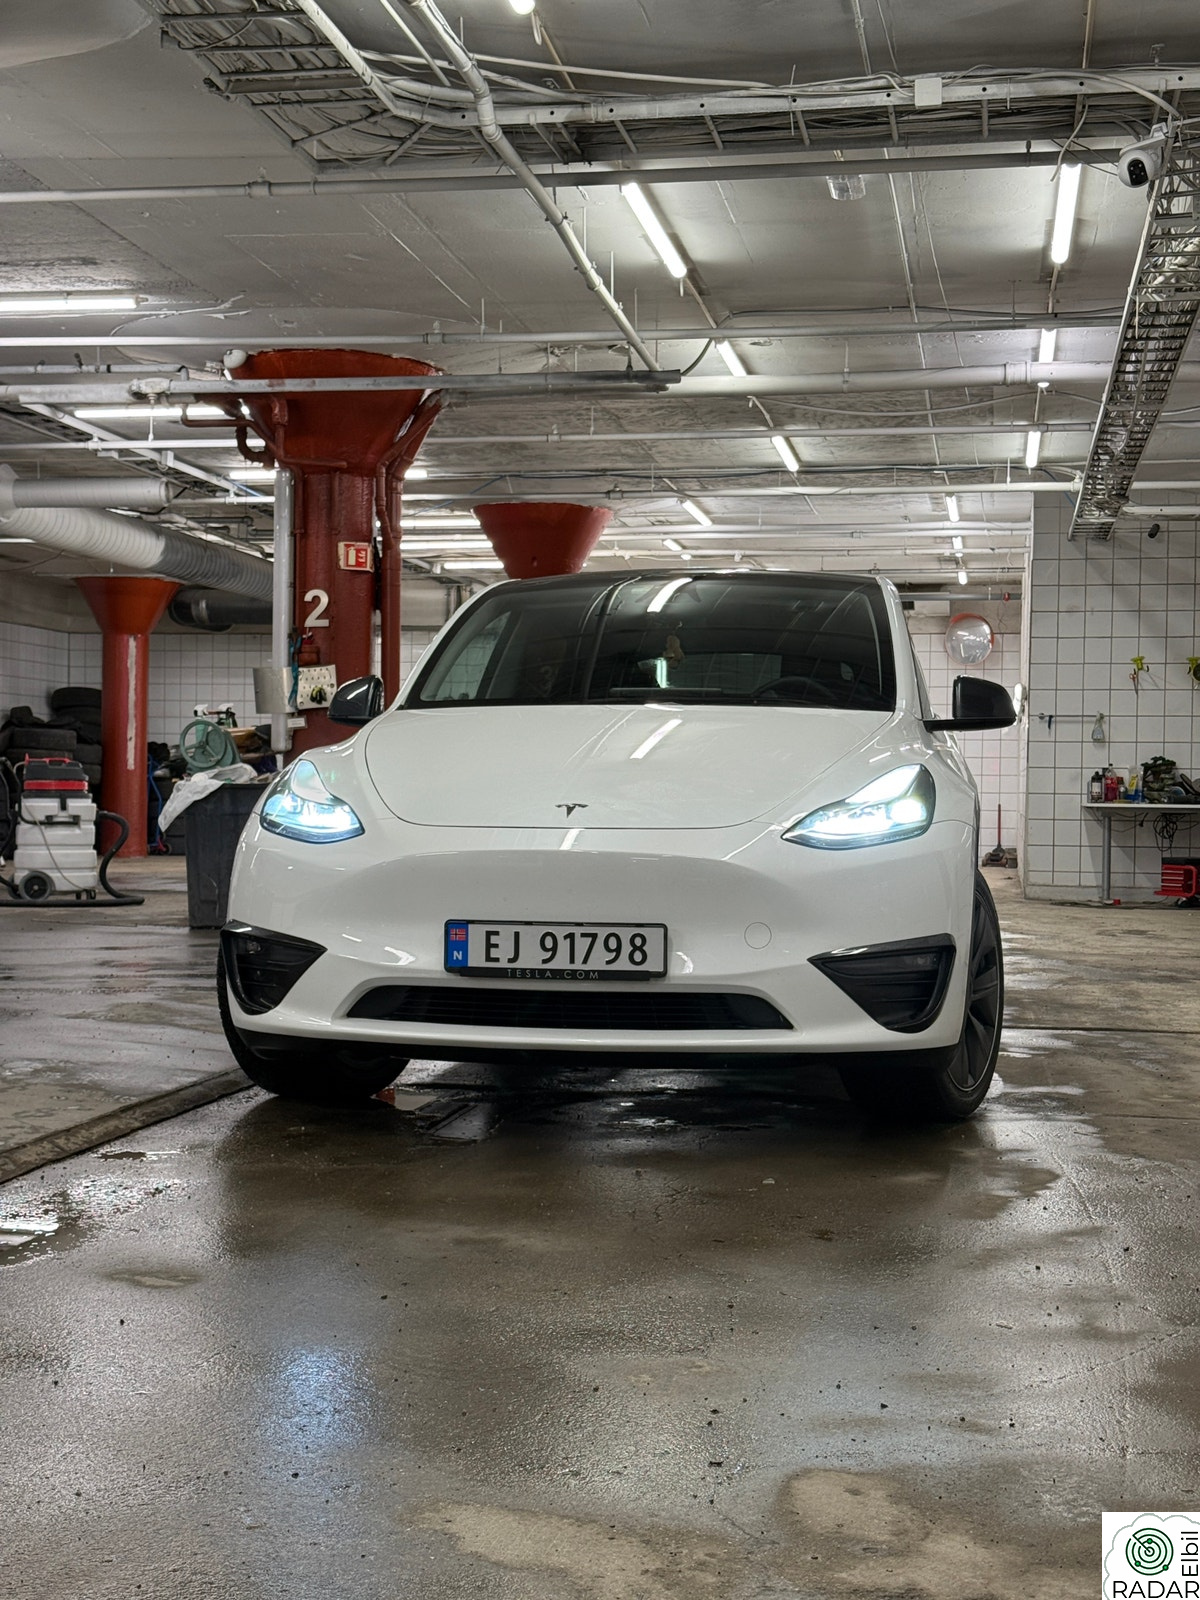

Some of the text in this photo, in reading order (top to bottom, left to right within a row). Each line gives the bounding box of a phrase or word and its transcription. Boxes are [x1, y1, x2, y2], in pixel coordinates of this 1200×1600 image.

[304, 589, 329, 628] 2
[453, 951, 463, 960] N
[484, 930, 648, 966] EJ 91798
[507, 969, 600, 979] TESLA.COM
